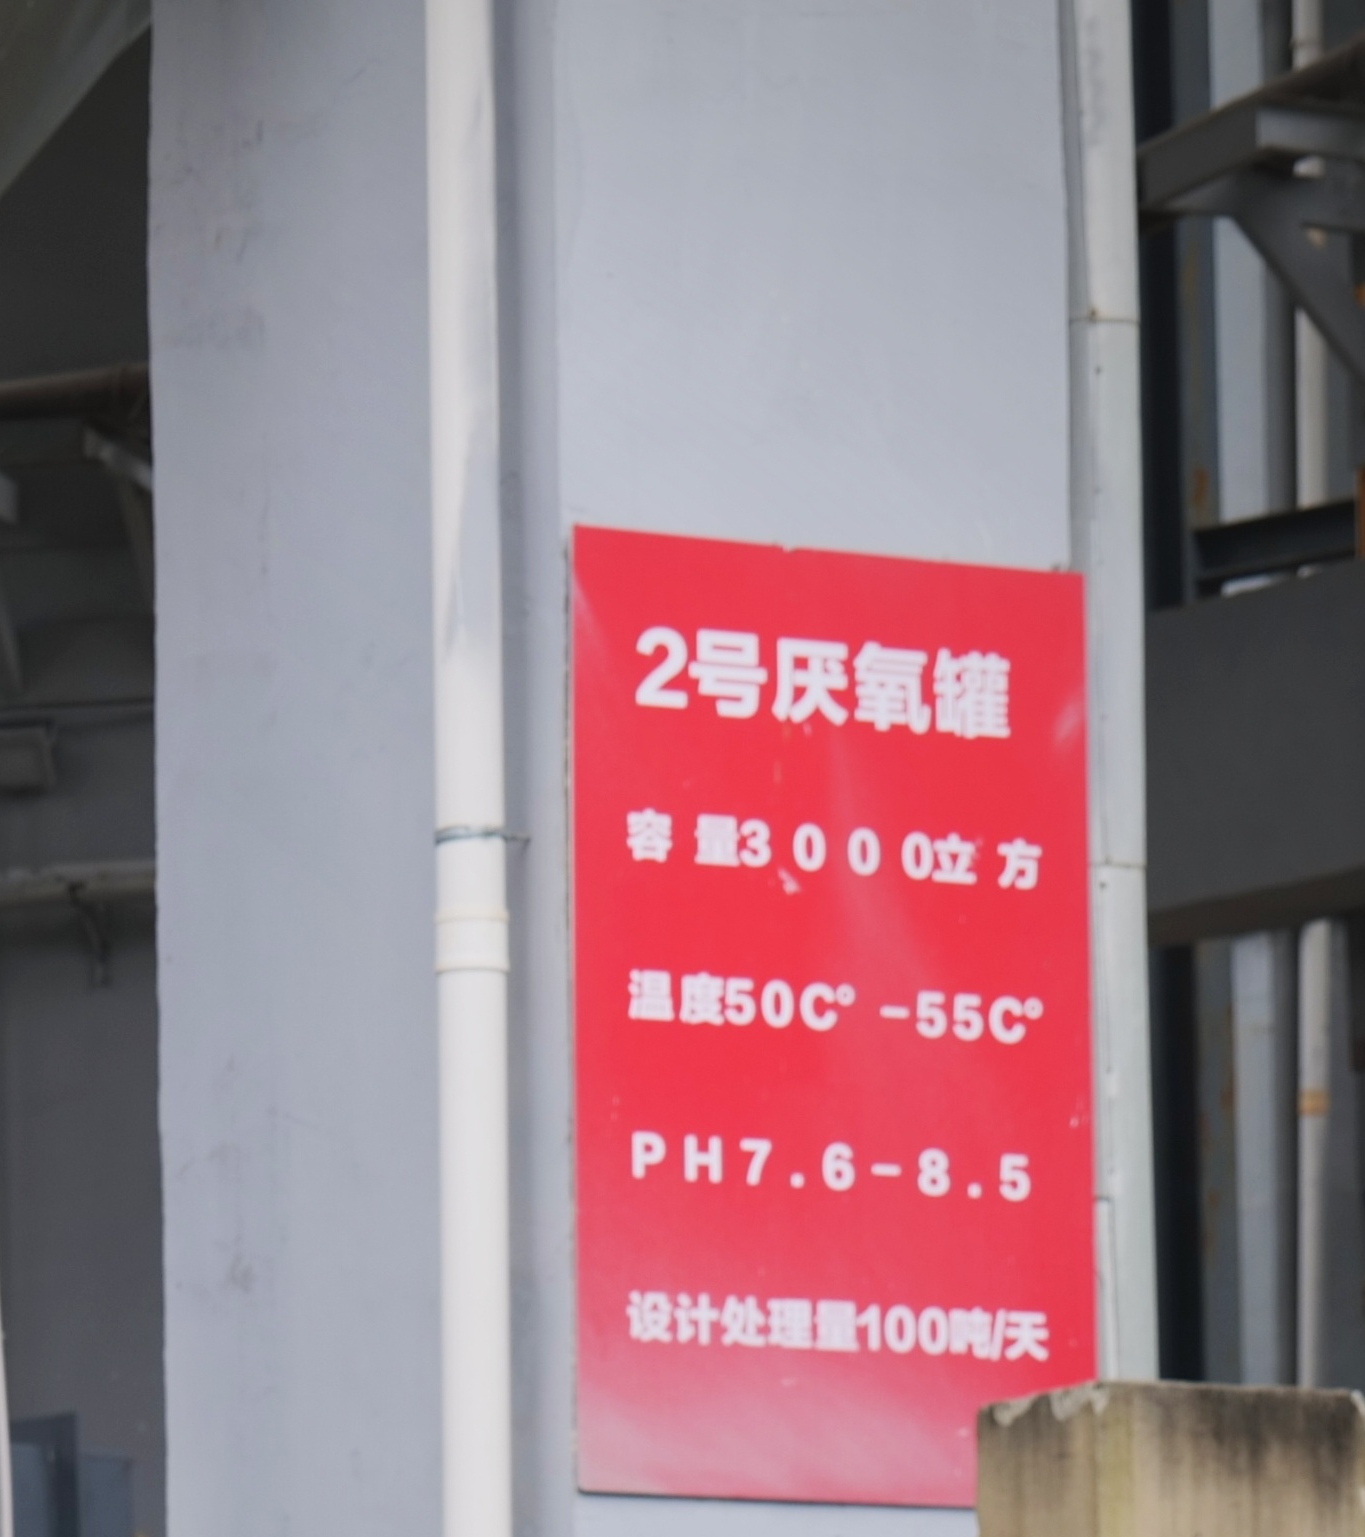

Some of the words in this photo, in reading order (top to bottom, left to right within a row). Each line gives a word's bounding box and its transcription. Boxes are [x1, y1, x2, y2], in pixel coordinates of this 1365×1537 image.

[634, 625, 1011, 739] 2号厌氧罐
[625, 1290, 1050, 1362] 设计处理量100吨/天
